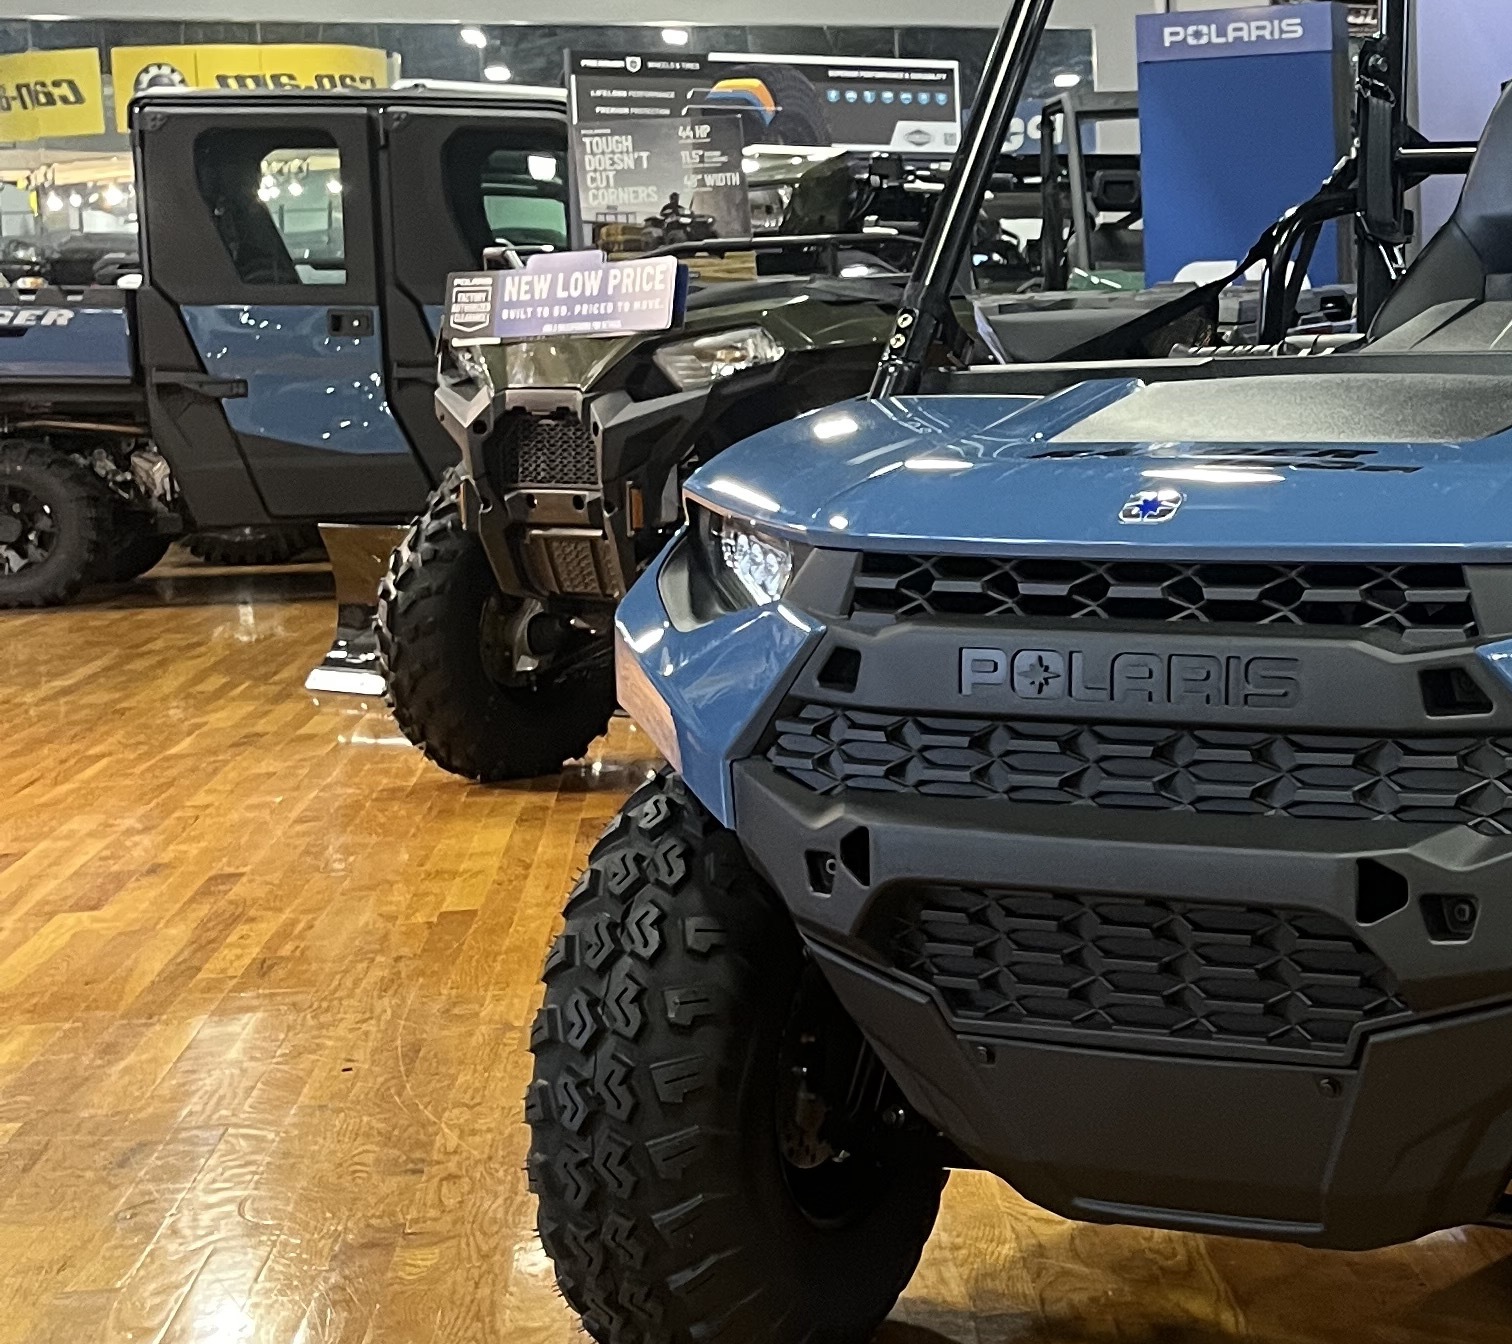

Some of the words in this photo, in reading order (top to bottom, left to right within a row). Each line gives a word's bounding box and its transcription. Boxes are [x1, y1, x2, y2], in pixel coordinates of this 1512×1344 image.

[1163, 18, 1303, 47] POLARIS
[582, 135, 633, 154] TOUGH
[584, 151, 650, 171] DOESN'T
[586, 171, 617, 188] CUT
[704, 172, 741, 187] WIDTH
[588, 185, 659, 205] CORNERS
[503, 273, 551, 303] NEW
[556, 268, 603, 299] LOW
[607, 264, 668, 296] PRICE
[958, 645, 1301, 709] POLARIS
